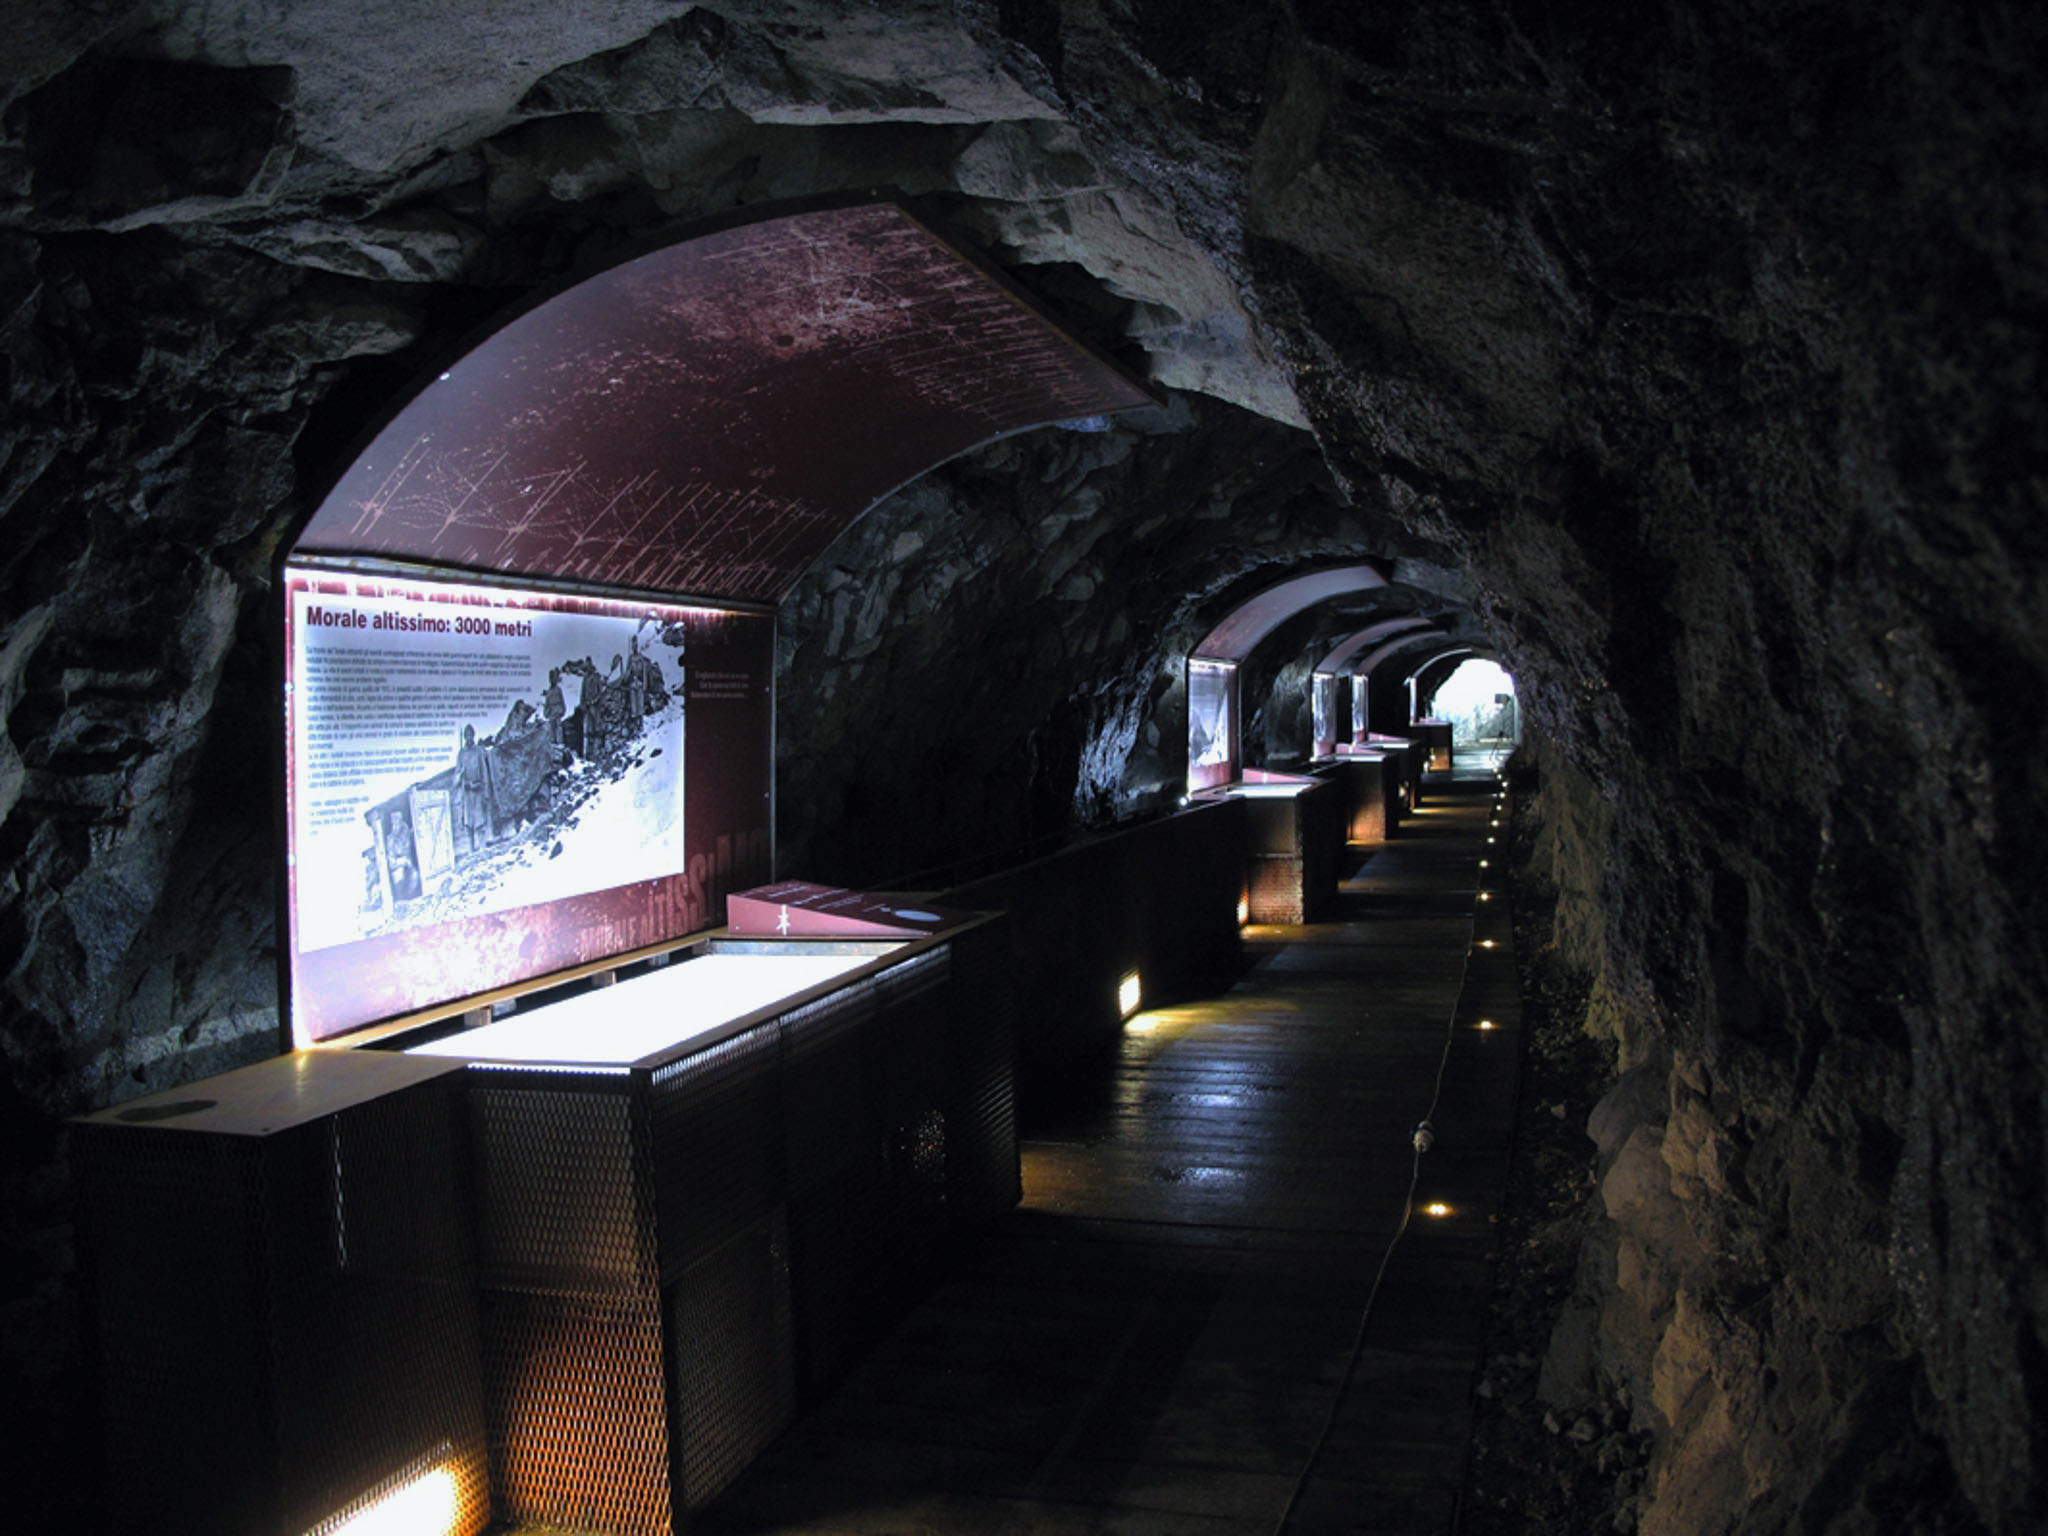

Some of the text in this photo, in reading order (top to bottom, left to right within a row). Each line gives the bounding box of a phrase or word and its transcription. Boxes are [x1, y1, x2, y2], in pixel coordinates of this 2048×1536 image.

[307, 606, 532, 637] Morale altissimo: 3000 metri
